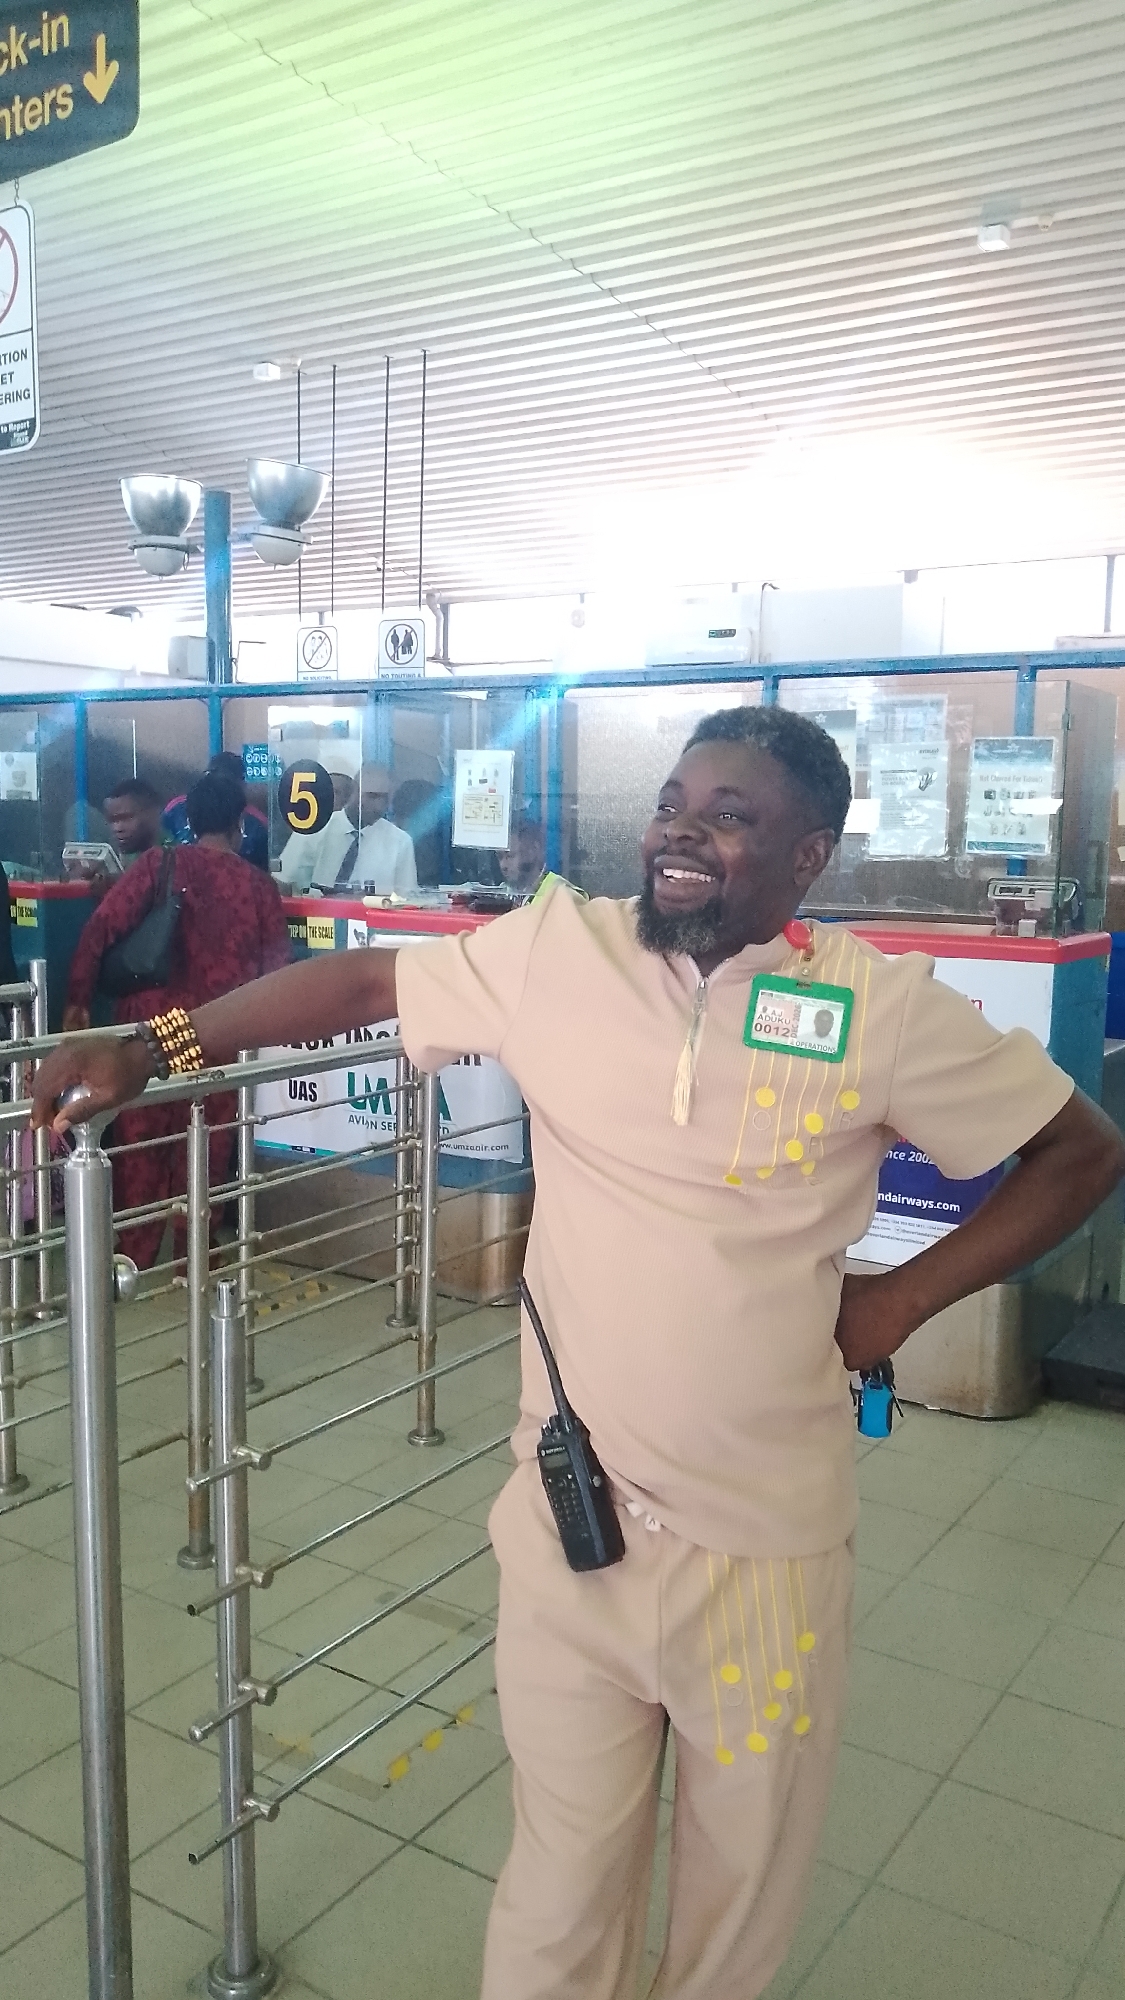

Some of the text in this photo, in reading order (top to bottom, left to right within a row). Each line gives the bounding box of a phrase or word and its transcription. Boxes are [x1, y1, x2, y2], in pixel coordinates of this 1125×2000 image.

[0, 348, 28, 366] TION
[287, 772, 319, 829] 5
[318, 926, 333, 939] SCALE
[757, 1014, 791, 1025] ADUKU
[754, 1022, 790, 1037] 0012
[795, 1040, 837, 1053] OPERATIONS
[289, 1077, 318, 1102] UAS
[877, 1192, 960, 1212] ndairways.com
